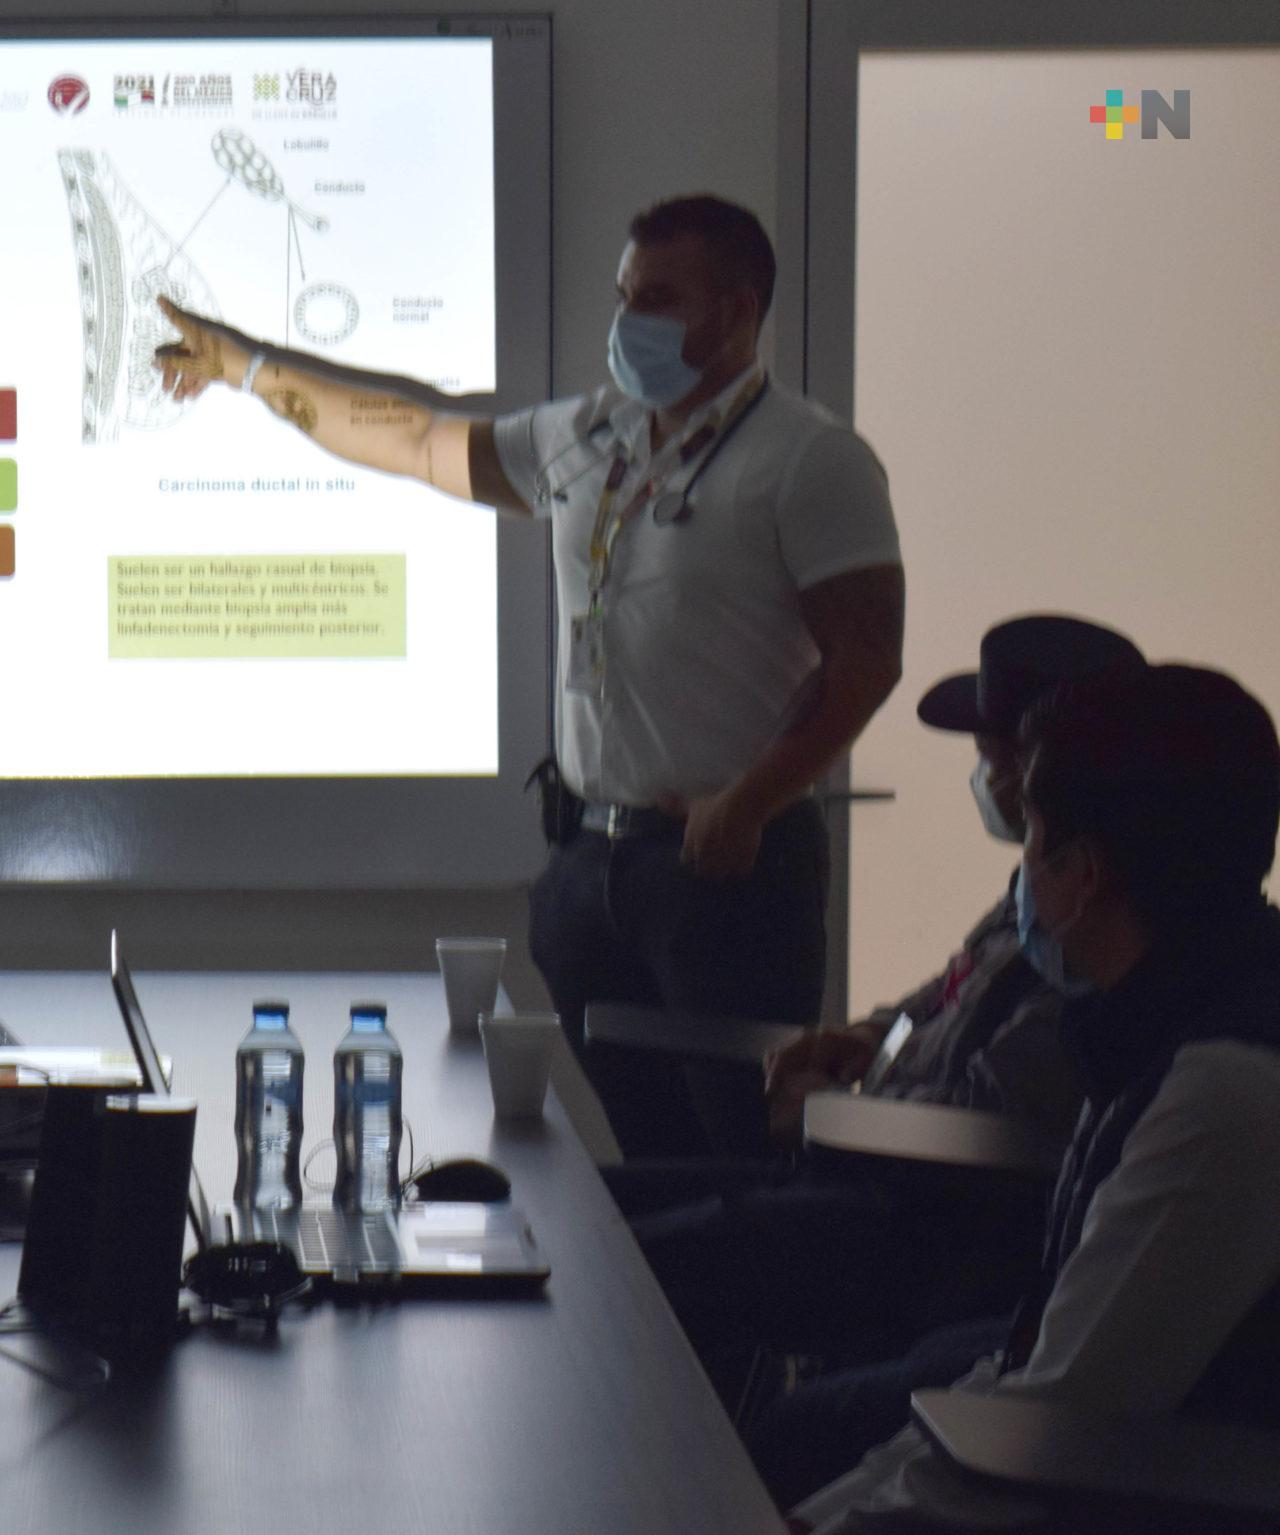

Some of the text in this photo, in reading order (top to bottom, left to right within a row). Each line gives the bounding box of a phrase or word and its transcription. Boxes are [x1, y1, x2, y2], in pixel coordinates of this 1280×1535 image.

[114, 73, 155, 89] 2021
[314, 181, 366, 192] Conducto
[392, 297, 444, 308] Conducto
[392, 311, 430, 322] normal
[158, 478, 356, 492] Carcinoma ductal in situ
[116, 562, 160, 576] Suelen
[164, 564, 184, 576] ser
[189, 564, 204, 576] un
[210, 562, 260, 578] hallazgo
[266, 562, 305, 576] casual
[310, 562, 325, 576] de
[116, 583, 160, 596] Suelen
[164, 585, 184, 596] ser
[190, 582, 255, 596] bilaterales
[260, 585, 267, 600] y
[374, 582, 389, 596] Se
[116, 602, 156, 615] tratan
[160, 602, 221, 615] mediante
[276, 602, 318, 617] amplia
[224, 624, 231, 640] y
[236, 622, 314, 638] seguimiento
